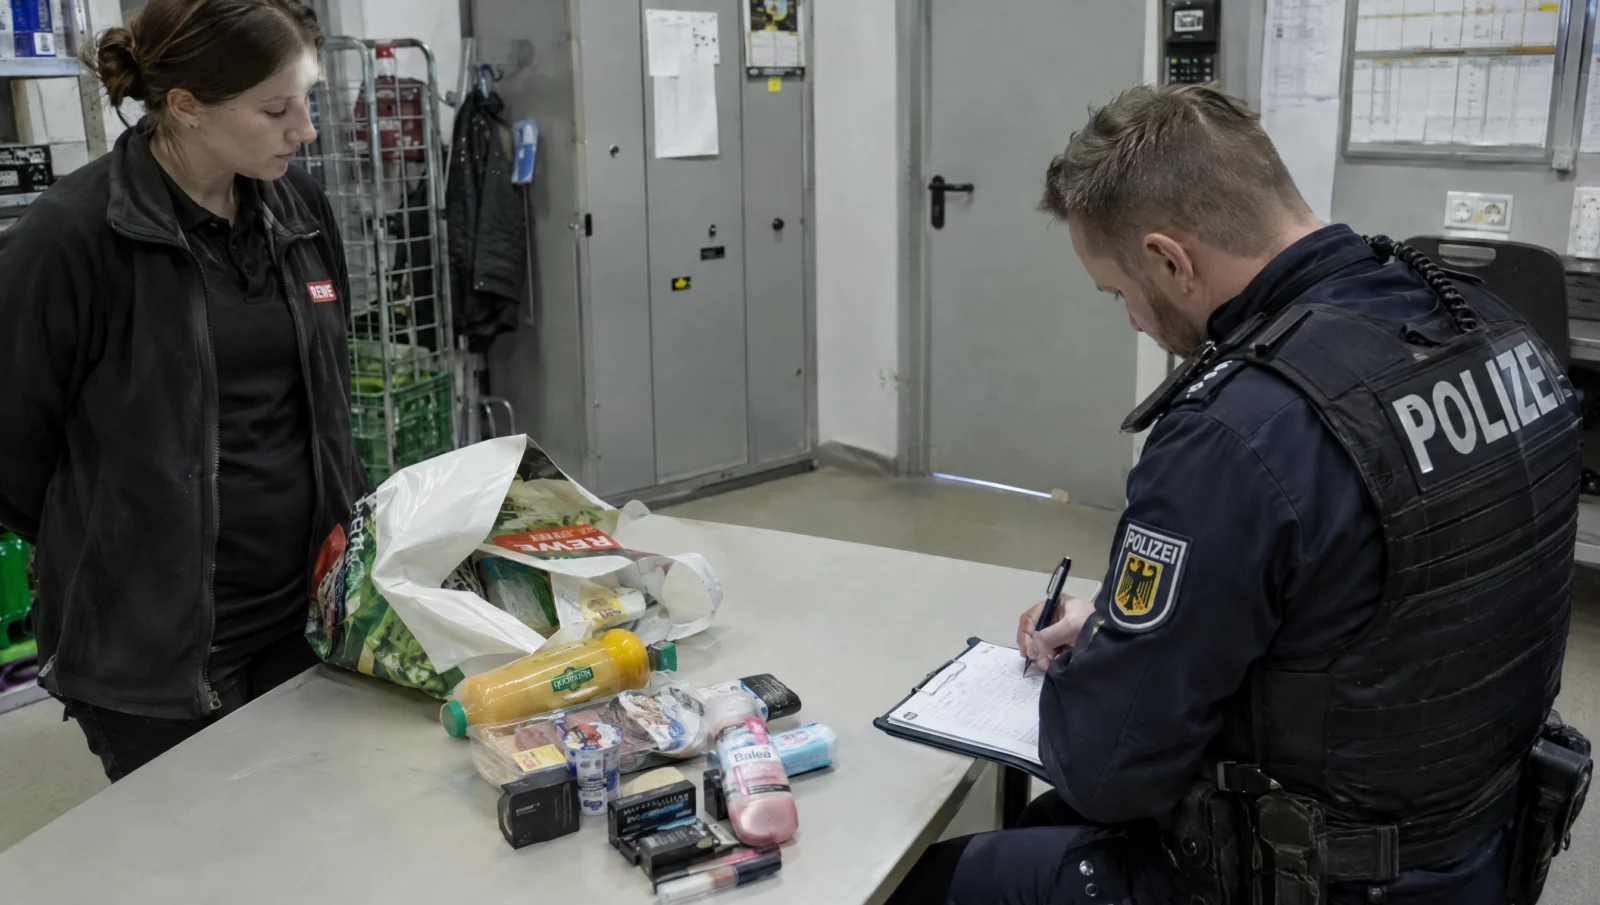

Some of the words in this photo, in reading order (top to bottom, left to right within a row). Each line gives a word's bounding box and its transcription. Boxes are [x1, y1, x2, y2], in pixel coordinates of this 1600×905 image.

[309, 284, 335, 299] REWE
[513, 535, 614, 551] REWE
[1125, 531, 1179, 565] POLIZEI
[734, 750, 772, 762] Balea
